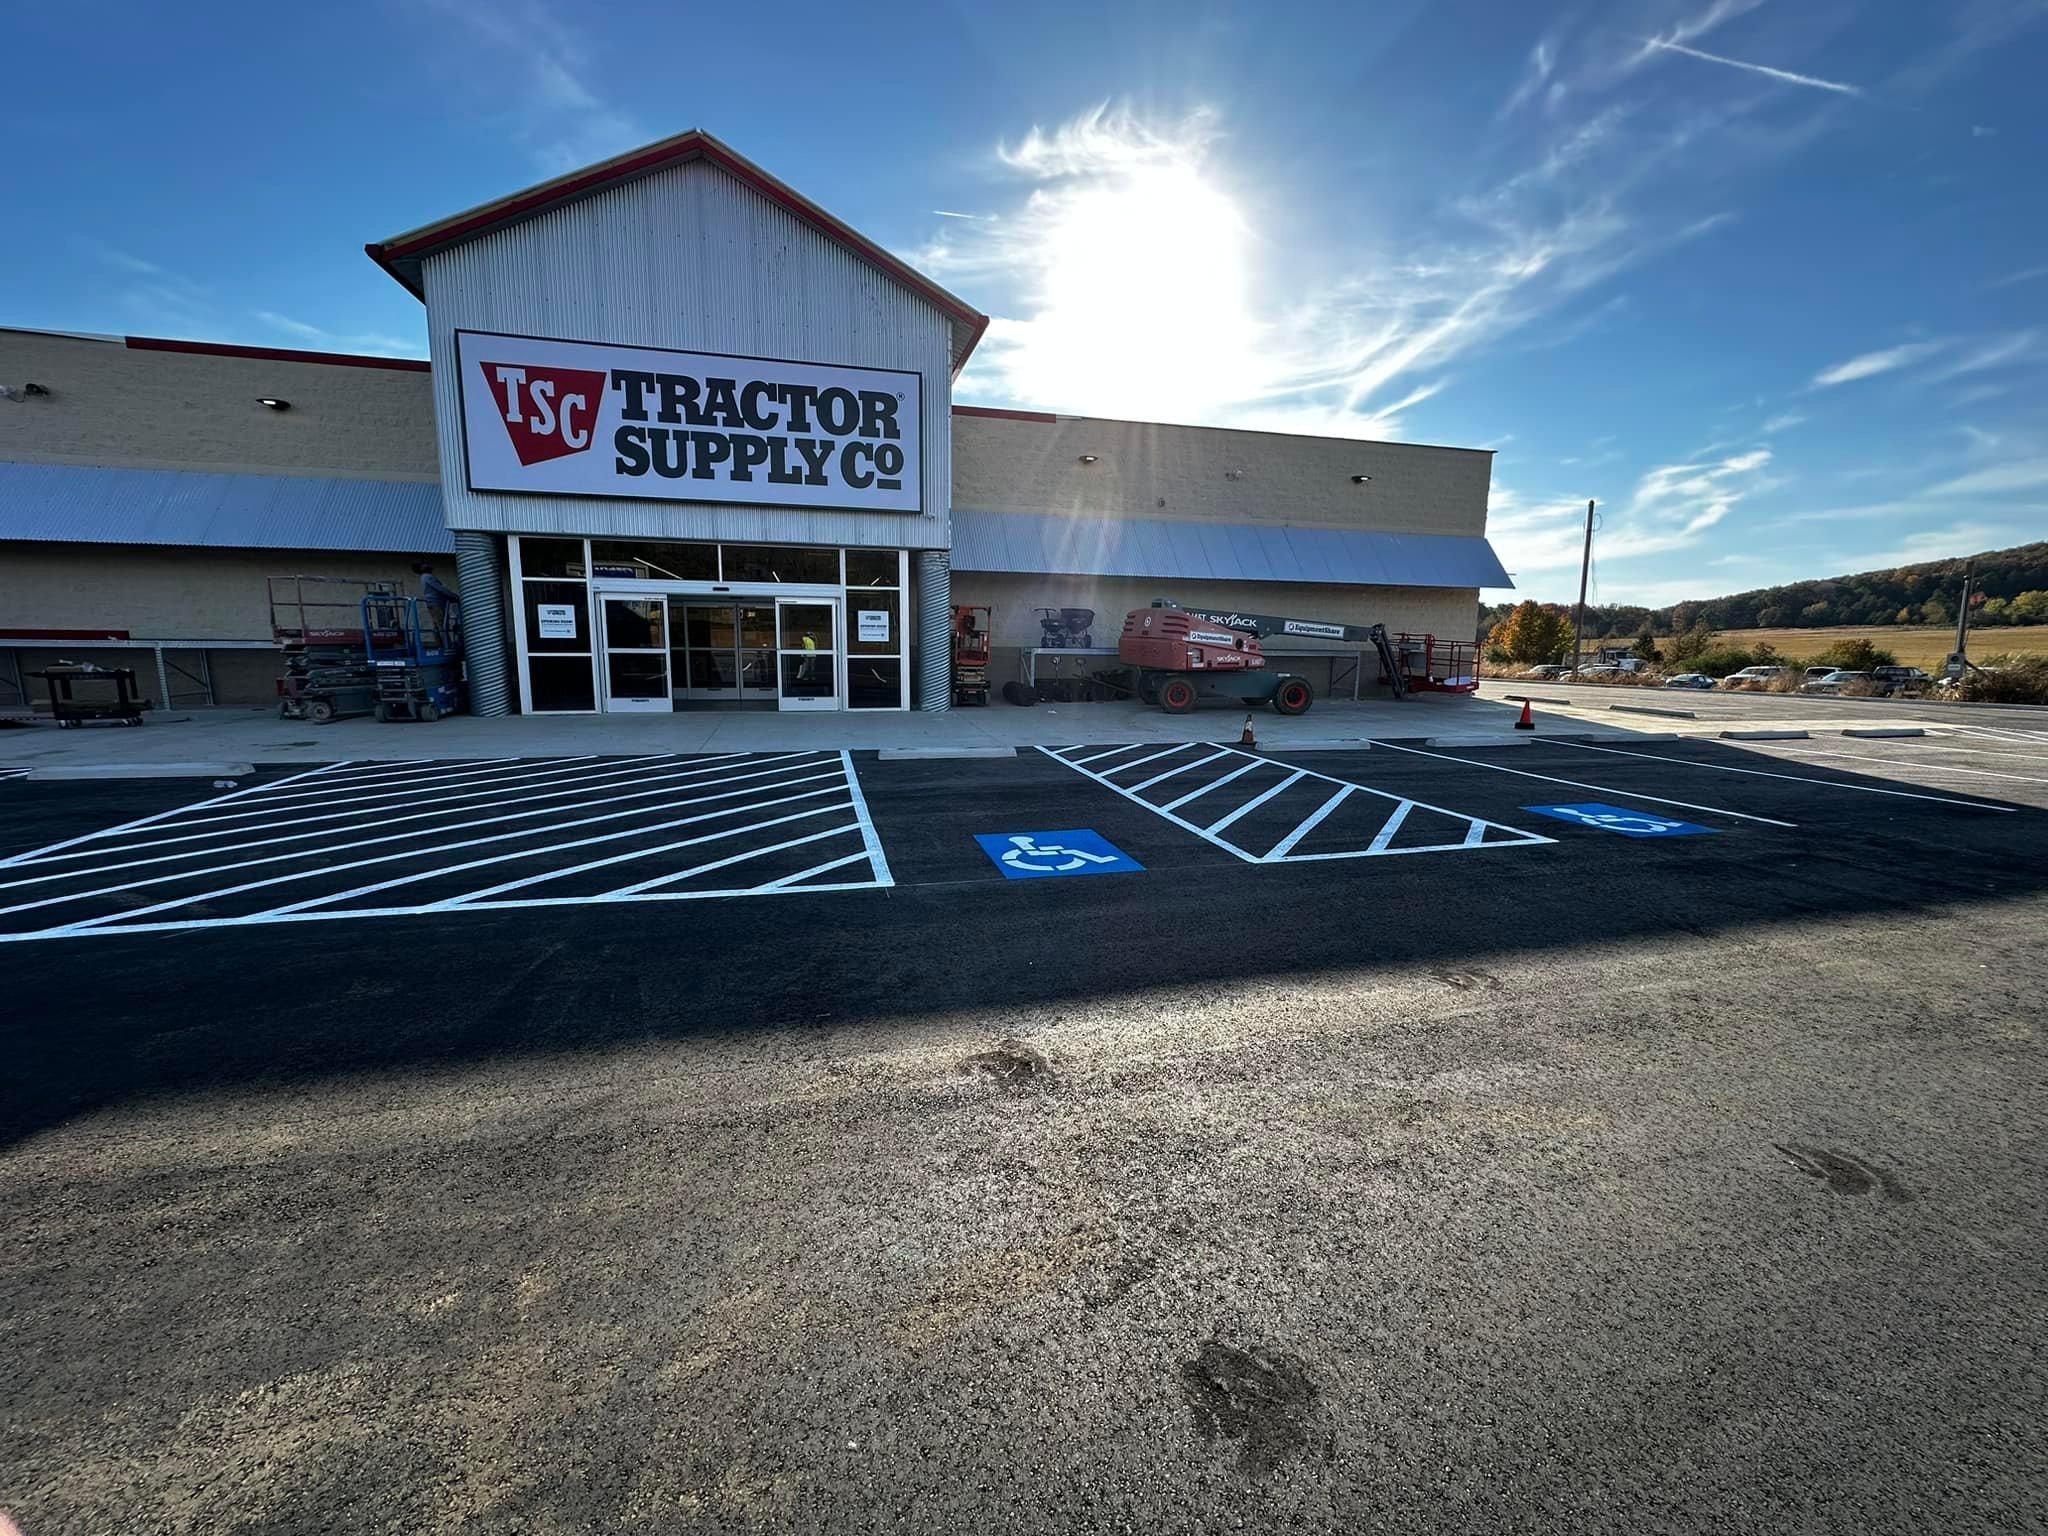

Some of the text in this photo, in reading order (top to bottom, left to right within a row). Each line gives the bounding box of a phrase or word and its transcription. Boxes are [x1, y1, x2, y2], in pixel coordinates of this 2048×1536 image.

[496, 366, 588, 449] TSC
[611, 368, 901, 440] TRACTOR
[614, 425, 835, 486] SUPPLY
[1210, 614, 1257, 627] SKYJACK
